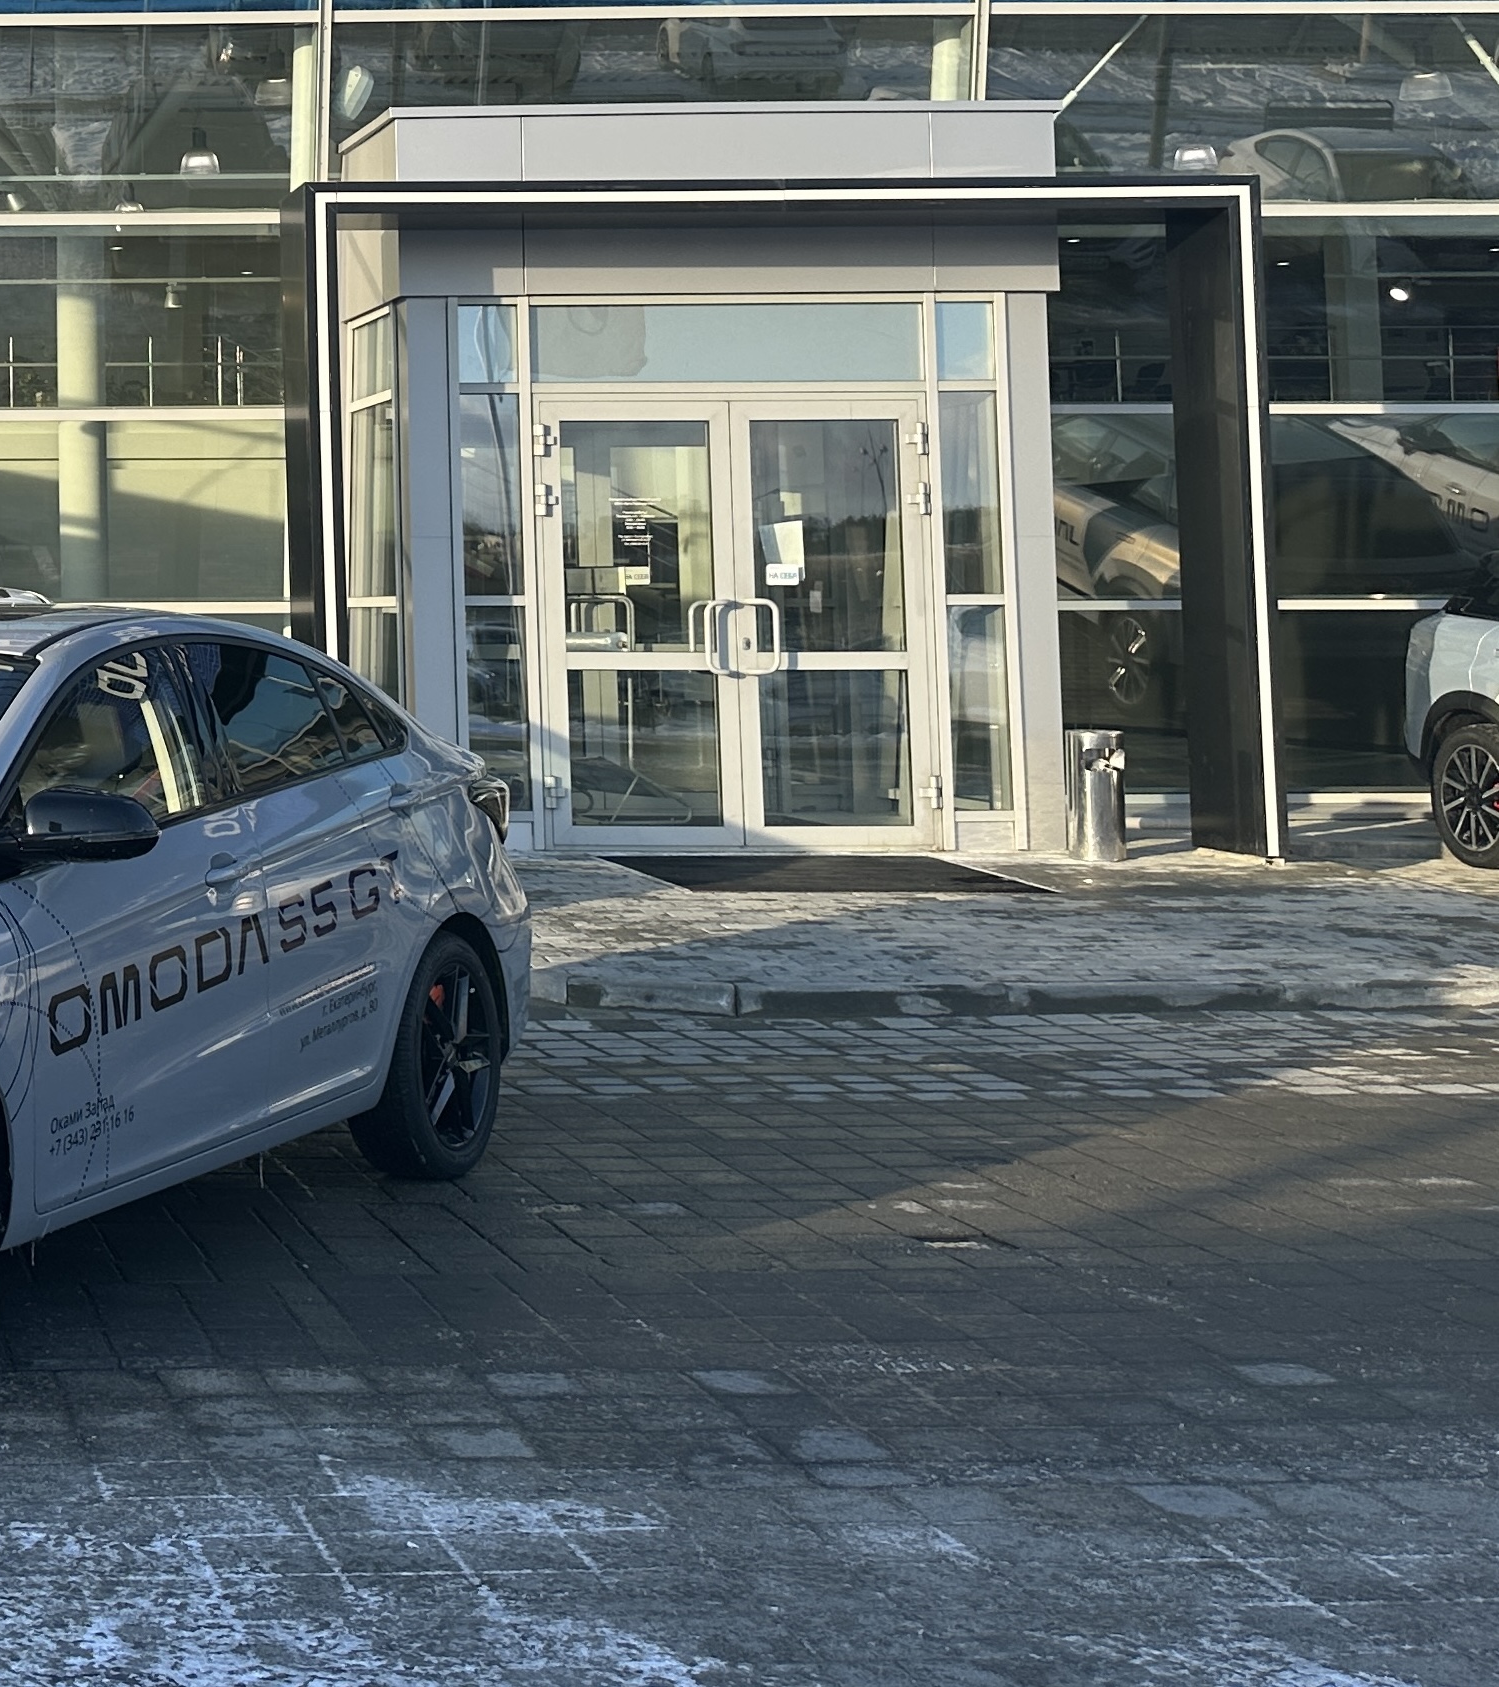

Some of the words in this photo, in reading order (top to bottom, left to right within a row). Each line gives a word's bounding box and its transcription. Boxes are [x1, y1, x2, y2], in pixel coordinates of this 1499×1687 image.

[48, 912, 270, 1056] OMODA
[277, 880, 338, 953] S5
[50, 1108, 83, 1134] Оками
[62, 1126, 88, 1156] (343)
[124, 1104, 135, 1125] 16
